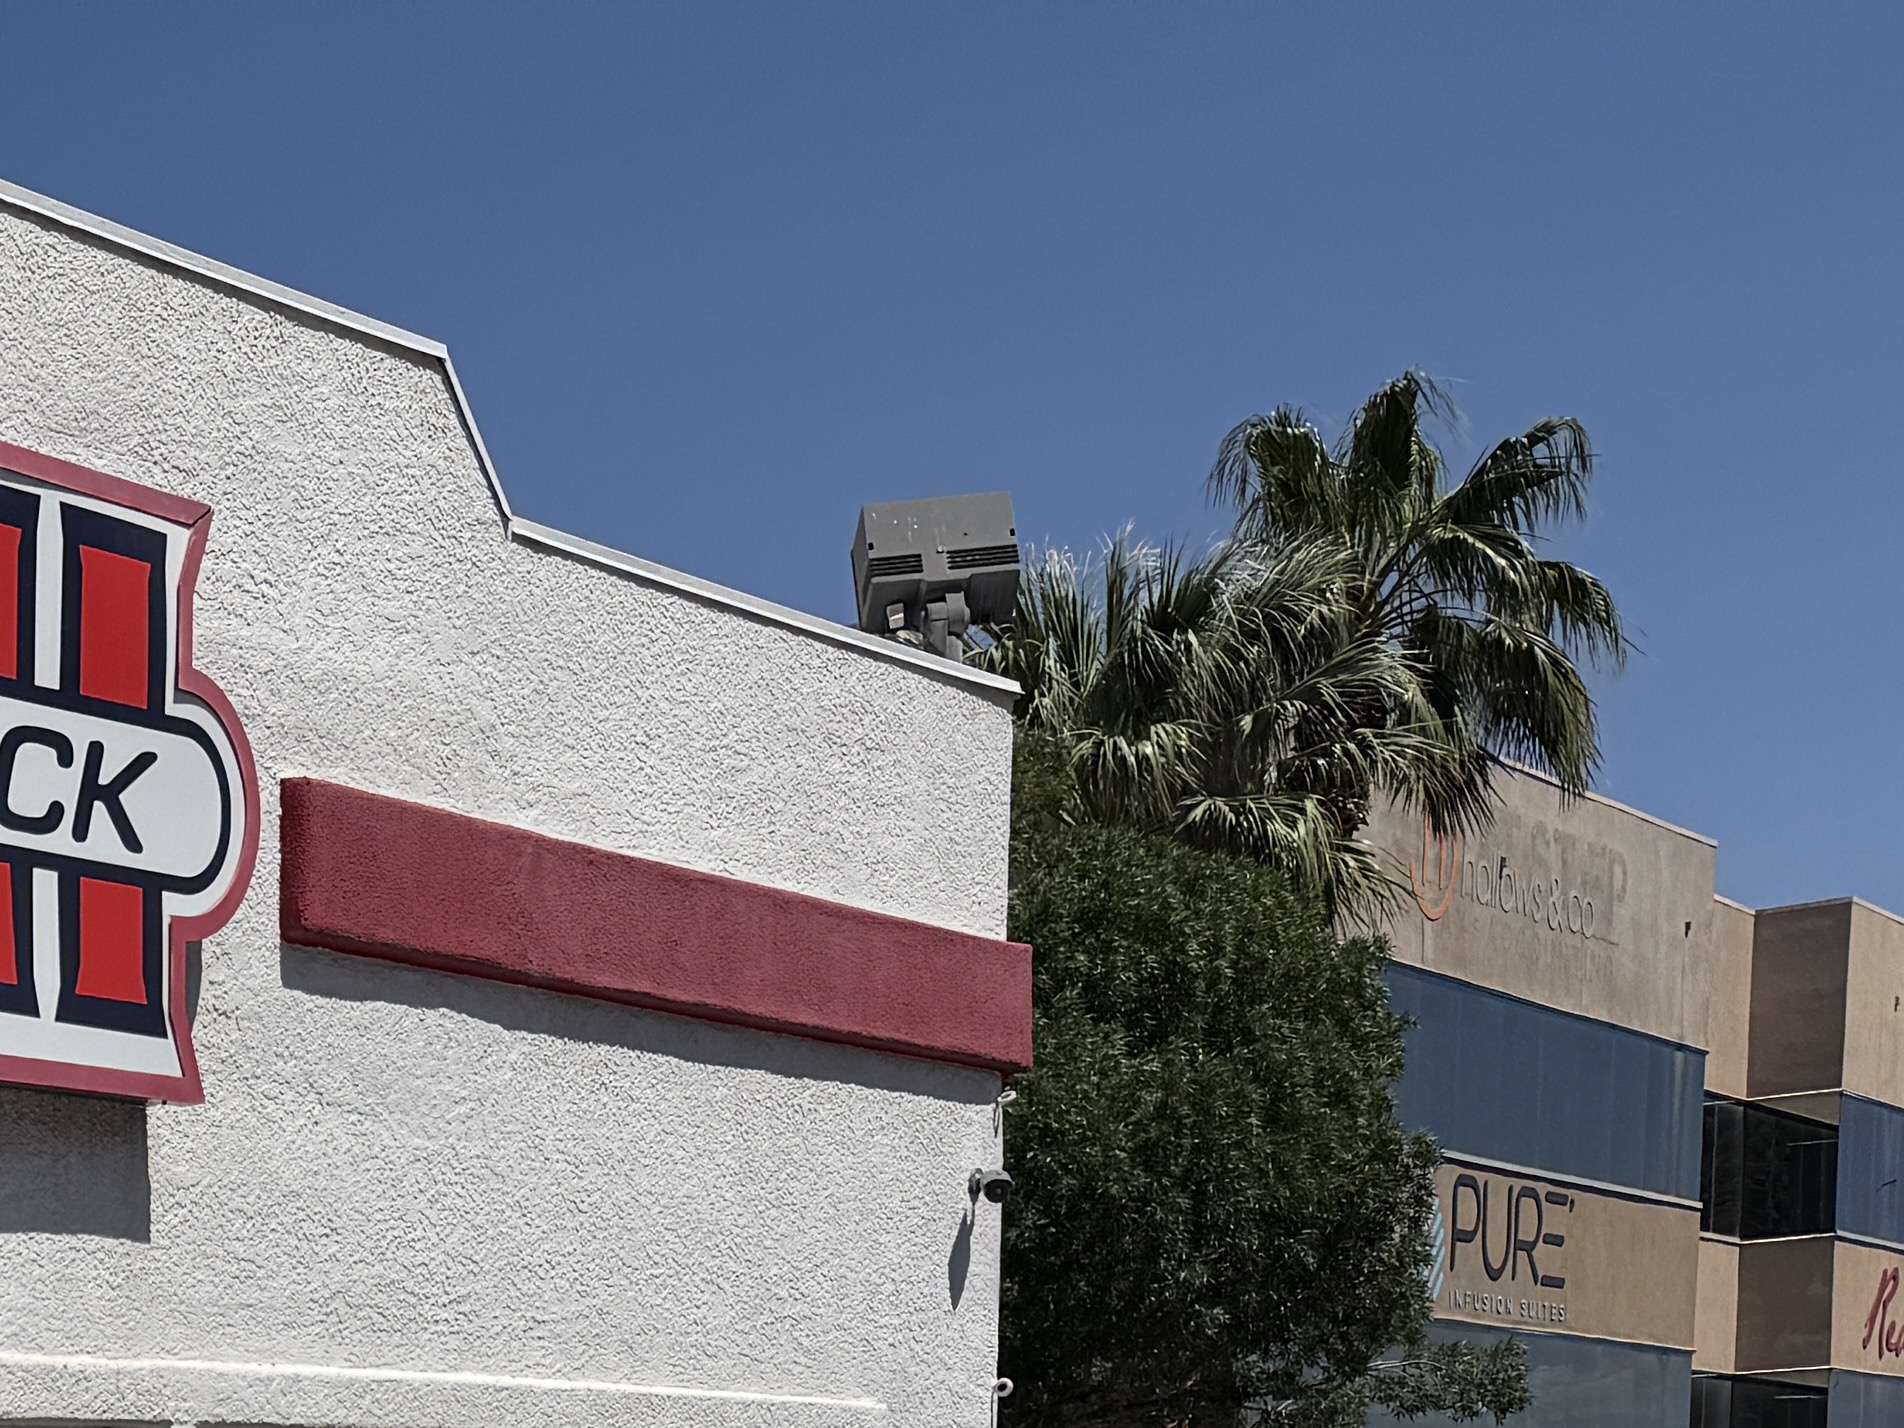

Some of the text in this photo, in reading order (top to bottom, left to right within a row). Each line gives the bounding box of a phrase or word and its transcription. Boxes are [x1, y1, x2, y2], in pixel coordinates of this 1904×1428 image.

[1450, 1173, 1569, 1289] PURE
[1448, 1289, 1567, 1323] INFUSION SUITES
